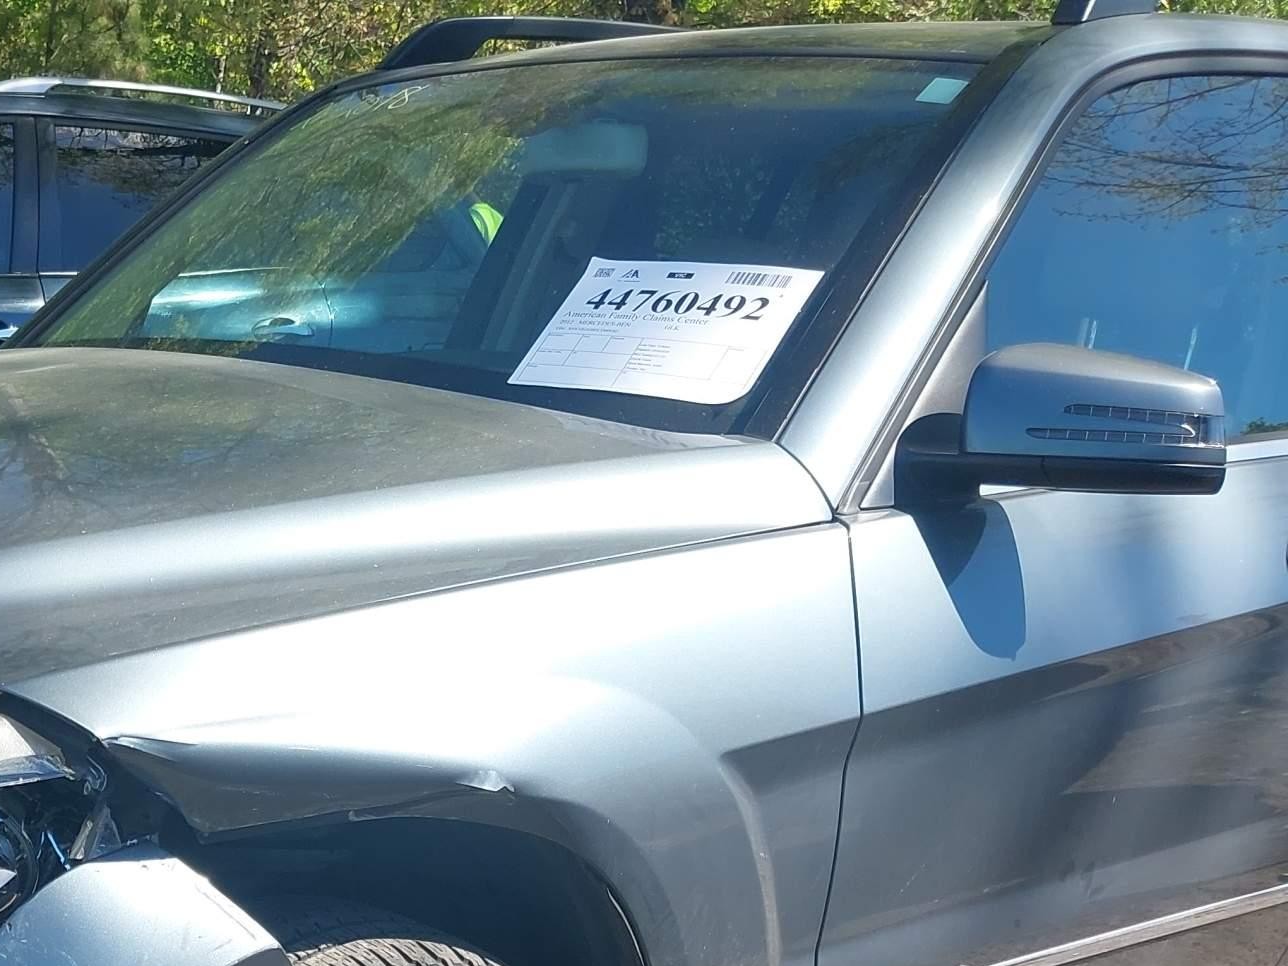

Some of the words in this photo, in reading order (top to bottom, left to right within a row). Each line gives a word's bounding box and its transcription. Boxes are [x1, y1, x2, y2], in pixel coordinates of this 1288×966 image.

[585, 288, 770, 321] 44760492
[563, 309, 607, 319] American
[608, 312, 641, 322] Family
[642, 313, 675, 323] Claims
[677, 316, 710, 326] Center
